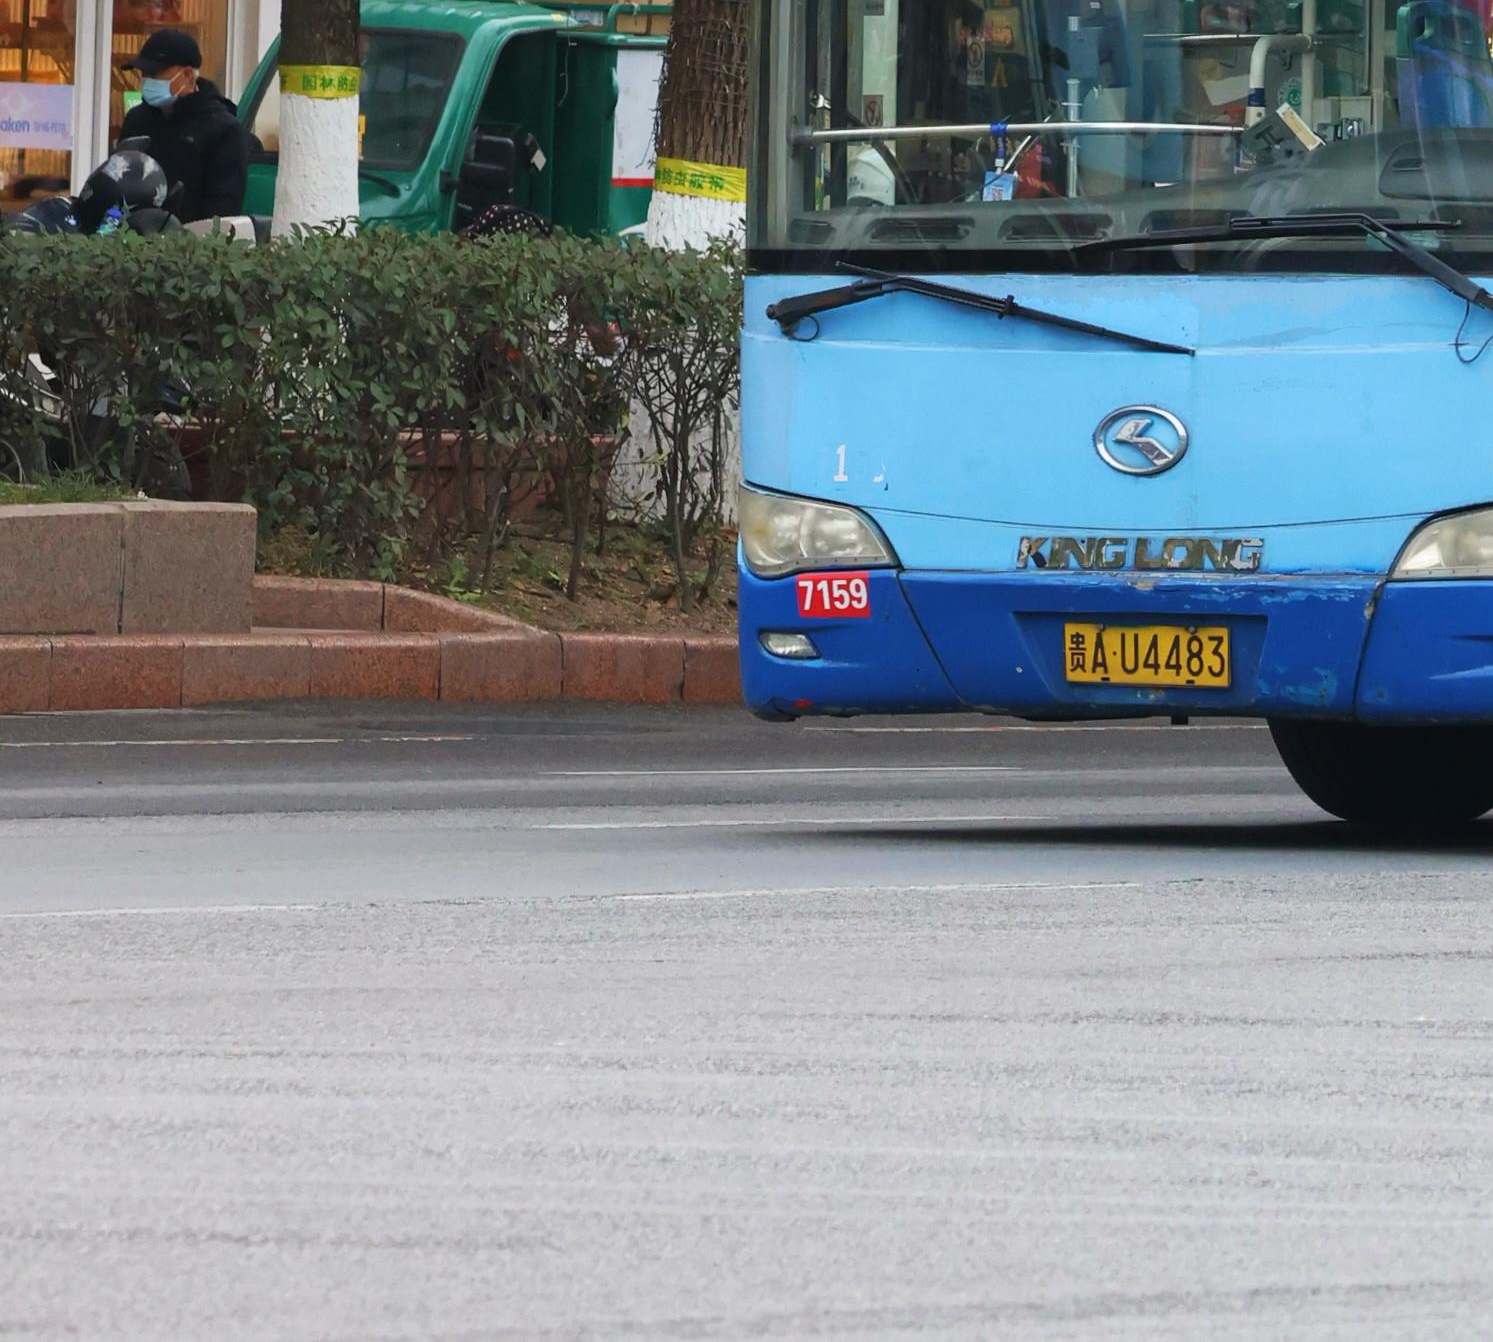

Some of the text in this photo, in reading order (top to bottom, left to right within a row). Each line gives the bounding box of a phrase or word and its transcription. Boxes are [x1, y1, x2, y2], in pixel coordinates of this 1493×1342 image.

[1016, 536, 1265, 572] KING LONG
[798, 578, 868, 611] 7159
